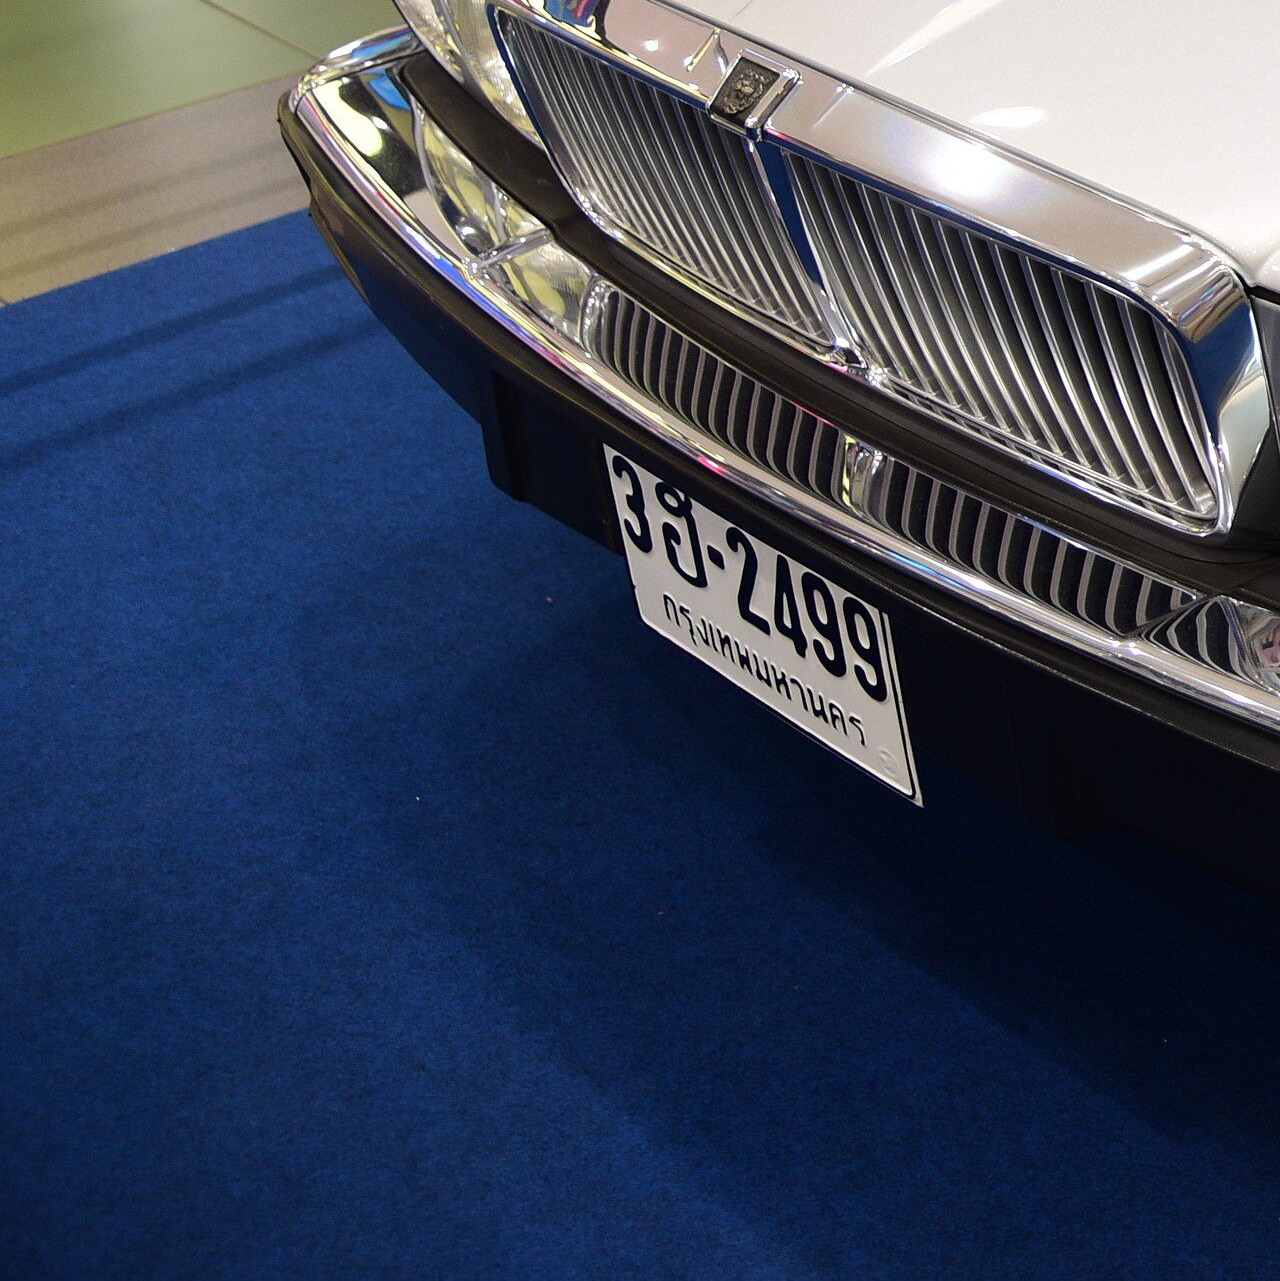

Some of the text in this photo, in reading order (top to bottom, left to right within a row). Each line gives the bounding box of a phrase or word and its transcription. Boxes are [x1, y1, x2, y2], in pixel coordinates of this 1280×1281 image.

[611, 454, 889, 704] 3ฮ-2499
[662, 593, 868, 748] กรุงเทพมหานคร
